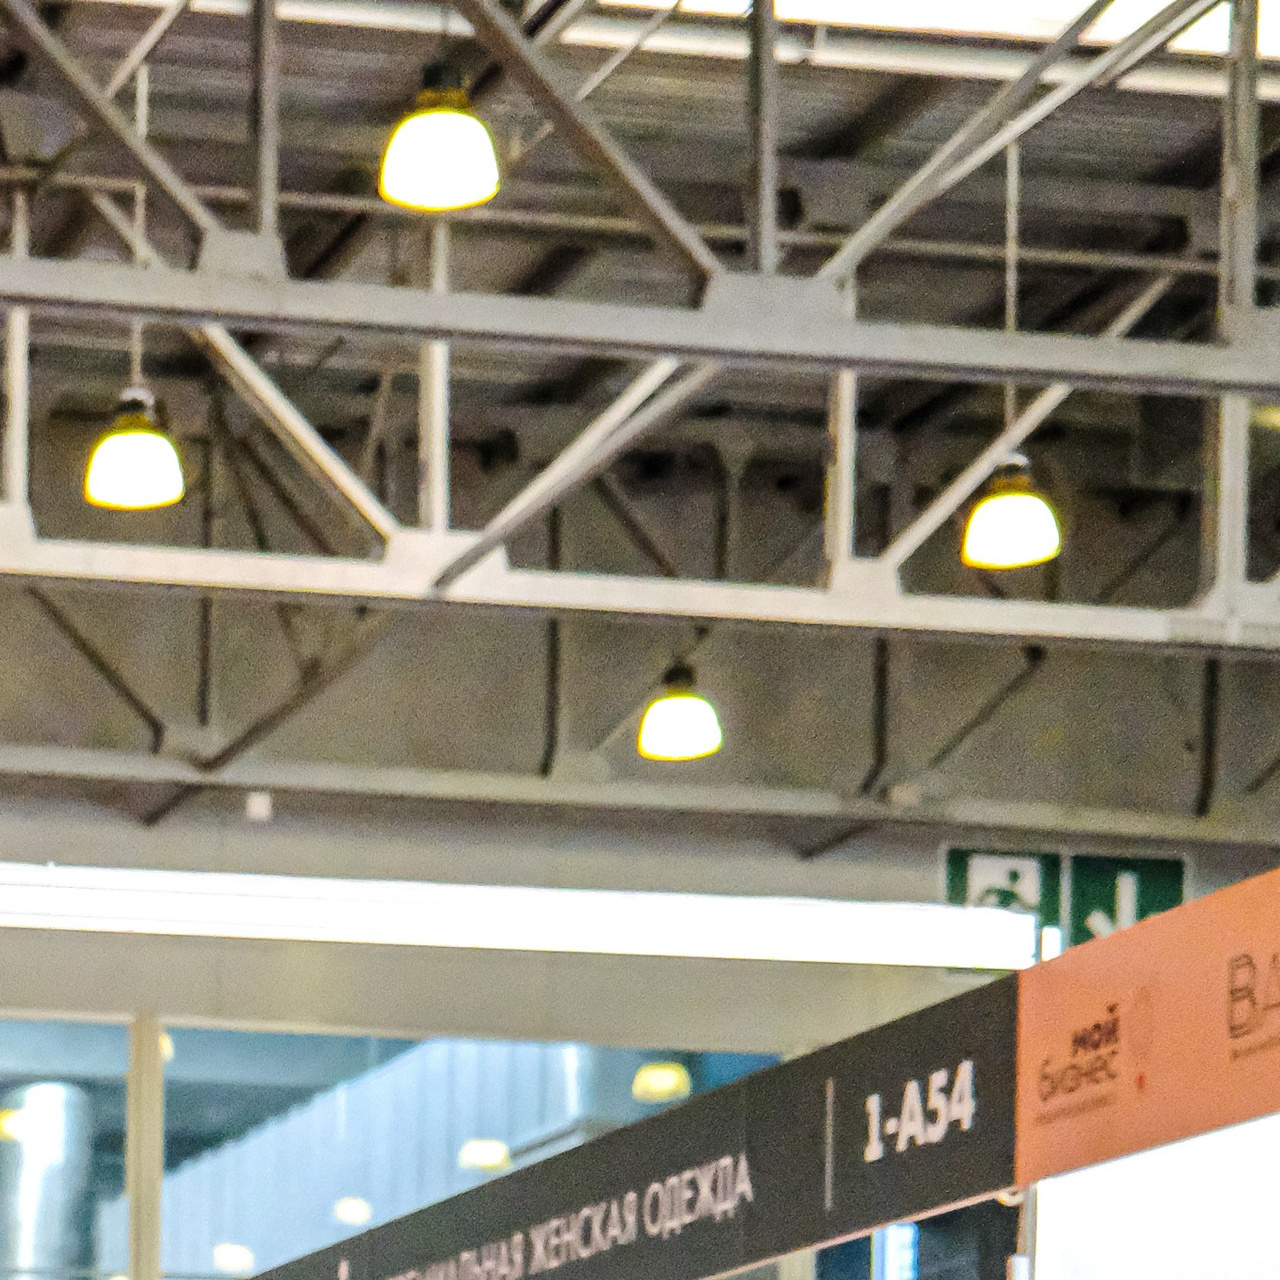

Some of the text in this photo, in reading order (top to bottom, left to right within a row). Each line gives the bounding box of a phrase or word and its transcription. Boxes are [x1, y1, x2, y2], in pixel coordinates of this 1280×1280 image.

[863, 1058, 976, 1164] 1-A54
[528, 1190, 638, 1275] ЖЕНСКАЯ
[642, 1151, 754, 1240] ОДЕЖДА
